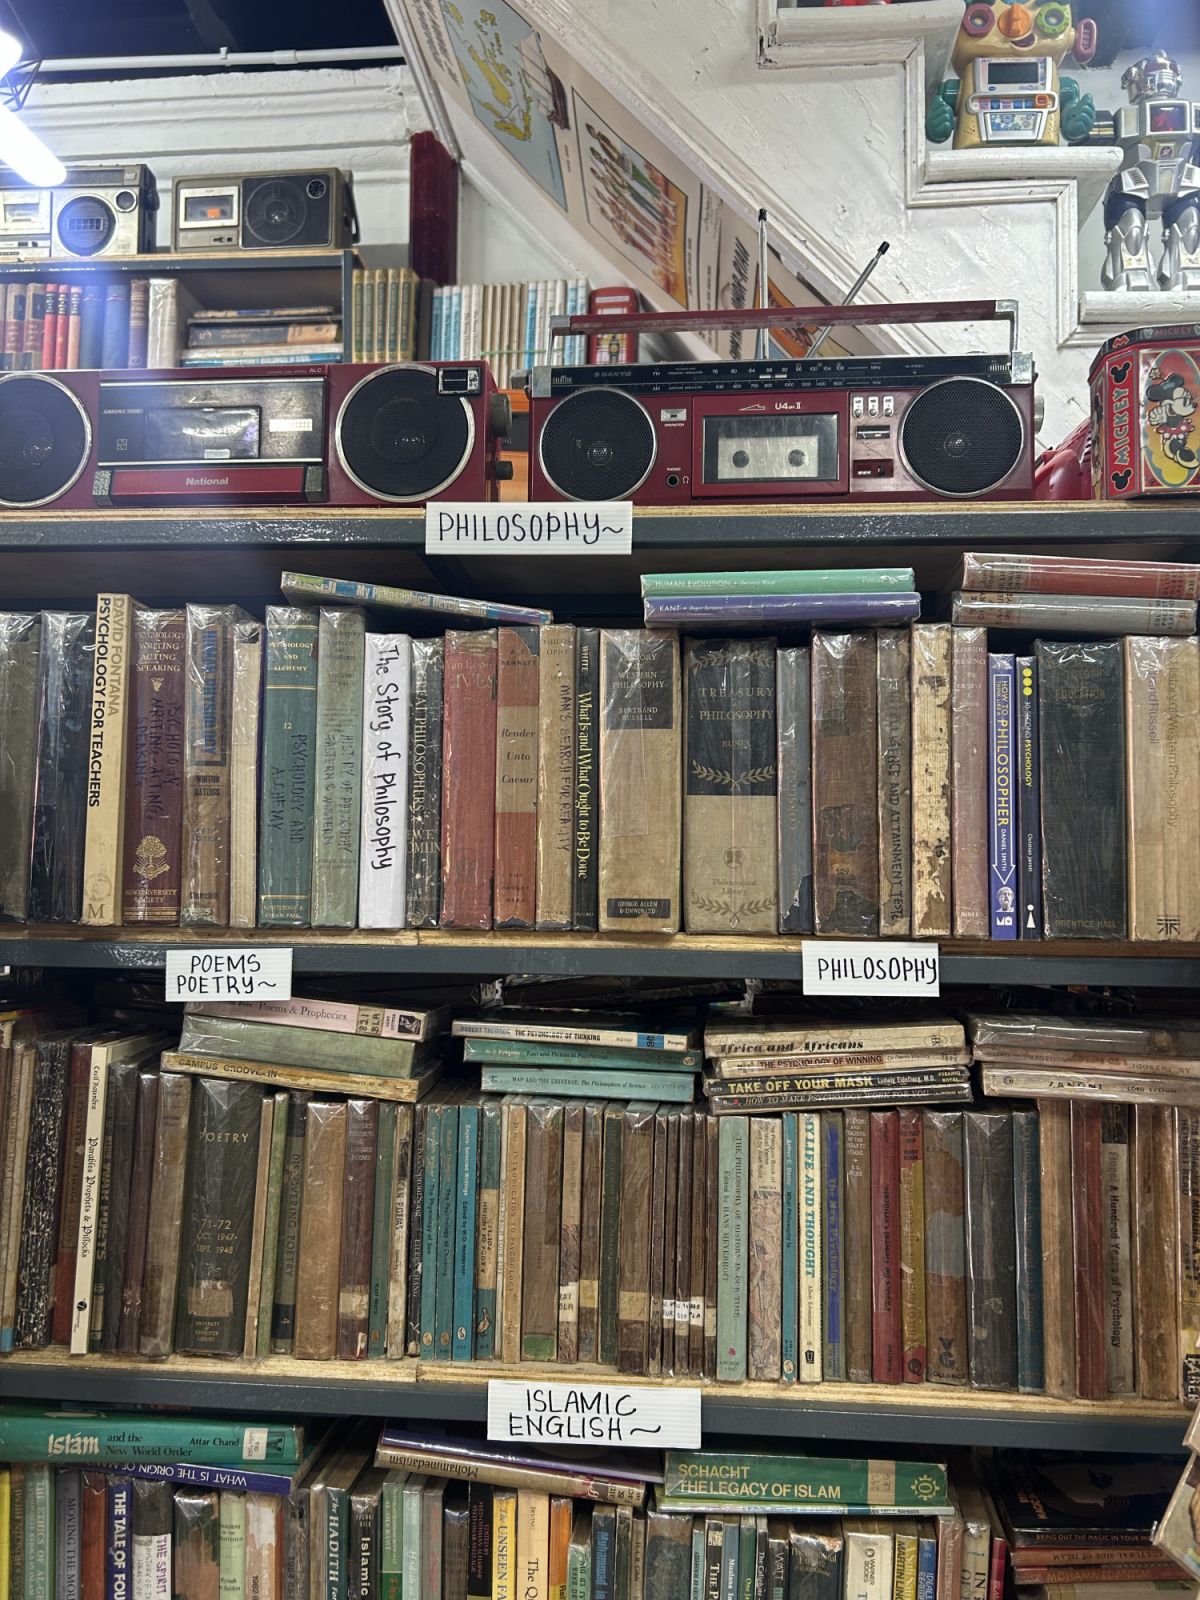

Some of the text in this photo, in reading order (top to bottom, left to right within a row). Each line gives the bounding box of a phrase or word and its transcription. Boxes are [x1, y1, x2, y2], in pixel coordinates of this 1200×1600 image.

[1113, 388, 1129, 465] MICKEY
[185, 477, 229, 487] National
[439, 512, 599, 545] PHILOSOPHY
[108, 597, 125, 716] DAVID FONTANA
[136, 664, 180, 673] SPEAKING
[141, 653, 176, 661] ACTING
[581, 645, 589, 672] WHITE
[273, 665, 307, 673] ALCHEMY
[619, 671, 657, 680] WESTERN
[612, 680, 664, 689] PHILOSOPHY
[699, 687, 774, 698] TREASURY
[88, 597, 111, 807] PSYCHOLOGY FOR TEACHERS
[618, 706, 657, 714] BERTRAND
[1001, 680, 1009, 716] HOW TO
[284, 722, 292, 730] 12
[622, 713, 652, 721] RUSSELL
[700, 710, 773, 722] PHILOSOPHY
[1024, 701, 1032, 738] 30-SECOND
[1148, 702, 1160, 744] Russell
[411, 670, 427, 812] GREAT PHILOSOPHERS
[501, 727, 536, 739] Render
[722, 739, 751, 748] RUNES
[369, 645, 400, 870] The Story of Philosophy
[506, 751, 531, 762] Unto
[1024, 739, 1033, 787] PSYCHOLOGY
[501, 773, 535, 785] Caesar
[995, 719, 1010, 826] PHILOSOPHER
[575, 692, 592, 879] What Is and What Ought to Be Done
[1000, 828, 1008, 871] DANIEL SMITH
[1026, 855, 1034, 873] Jarrett
[722, 887, 747, 895] Library
[618, 900, 658, 908] GEORGE ALLEN
[191, 954, 260, 973] POEMS
[818, 957, 937, 984] PHILOSOPHY
[177, 975, 253, 994] POETRY
[259, 1002, 348, 1021] Poems & Prophecies
[760, 1055, 882, 1069] THE PSYCHOLOGY OF WINNING
[91, 1065, 100, 1110] Cecil Rajendra
[728, 1077, 873, 1094] TAKE OFF YOUR MASK
[199, 1131, 250, 1144] POETRY
[86, 1137, 99, 1173] Parables
[722, 1170, 731, 1193] Edited
[734, 1157, 742, 1207] PHILOSOPHY
[82, 1175, 96, 1213] Prophets
[721, 1195, 730, 1204] by
[200, 1219, 232, 1230] 71-72
[285, 1153, 300, 1277] DISCOVERING POETRY
[395, 1201, 404, 1231] POEMS
[442, 1201, 450, 1238] Psychology
[735, 1210, 742, 1221] OF
[80, 1225, 93, 1258] Pillocks
[443, 1240, 450, 1248] of
[734, 1224, 742, 1260] HISTORY
[828, 1178, 837, 1292] The New Psychology
[722, 1232, 730, 1283] MEYERHOFF
[734, 1262, 741, 1271] IN
[527, 1389, 637, 1416] ISLAMIC
[106, 1432, 143, 1442] and the
[510, 1413, 622, 1440] ENGLISH
[106, 1445, 193, 1457] New World Order
[189, 1437, 239, 1446] Attar Chand
[138, 1464, 175, 1476] ORIGIN
[177, 1468, 199, 1480] THE
[200, 1471, 210, 1480] IS
[388, 1455, 480, 1479] Mohammedanism
[677, 1464, 751, 1479] SCHACHT
[212, 1473, 247, 1486] WHAT
[680, 1479, 841, 1499] THE LEGACY OF ISLAM
[35, 1481, 46, 1564] THE ETHICS OF
[65, 1497, 77, 1569] MOVING THE
[113, 1491, 127, 1569] THE TALE OF
[329, 1497, 340, 1581] The HADITH
[497, 1508, 509, 1580] The UNSEEN
[484, 1547, 489, 1556] BY
[595, 1531, 608, 1586] Muhammad
[896, 1541, 906, 1580] MARTIN
[156, 1536, 168, 1593] THE SPIRIT
[360, 1537, 371, 1596] Islamic
[527, 1559, 539, 1583] The
[709, 1563, 720, 1588] THE
[756, 1551, 765, 1596] The Caliphate
[774, 1552, 785, 1581] WATT
